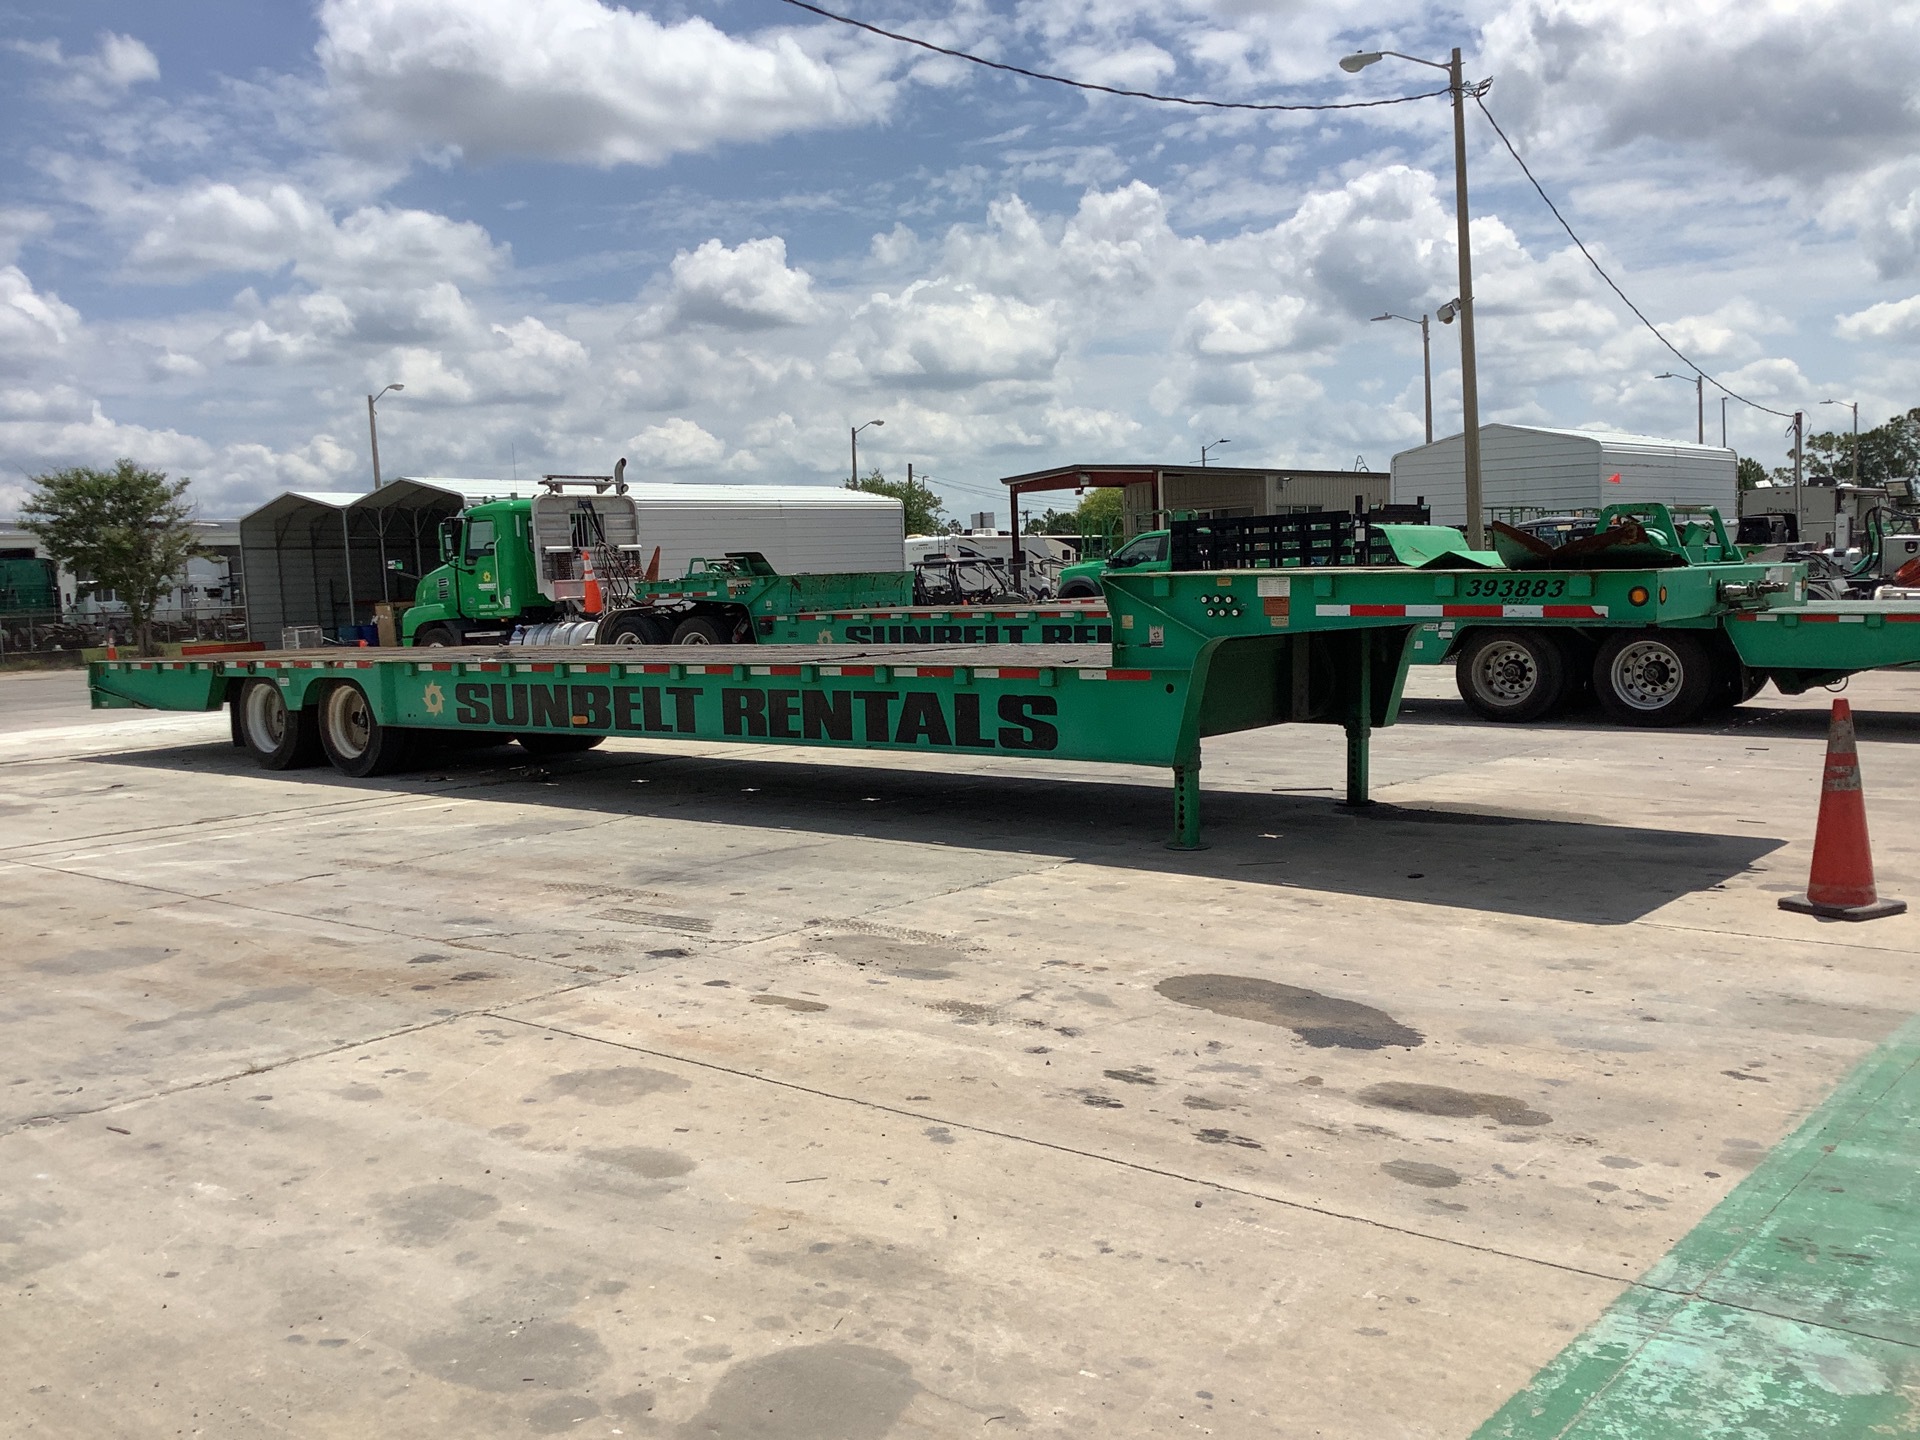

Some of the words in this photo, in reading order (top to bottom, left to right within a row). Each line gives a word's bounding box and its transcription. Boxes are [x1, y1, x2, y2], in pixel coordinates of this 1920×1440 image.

[1466, 579, 1566, 598] 393883
[455, 683, 703, 733] SUNBELT
[722, 688, 1058, 751] RENTALS
